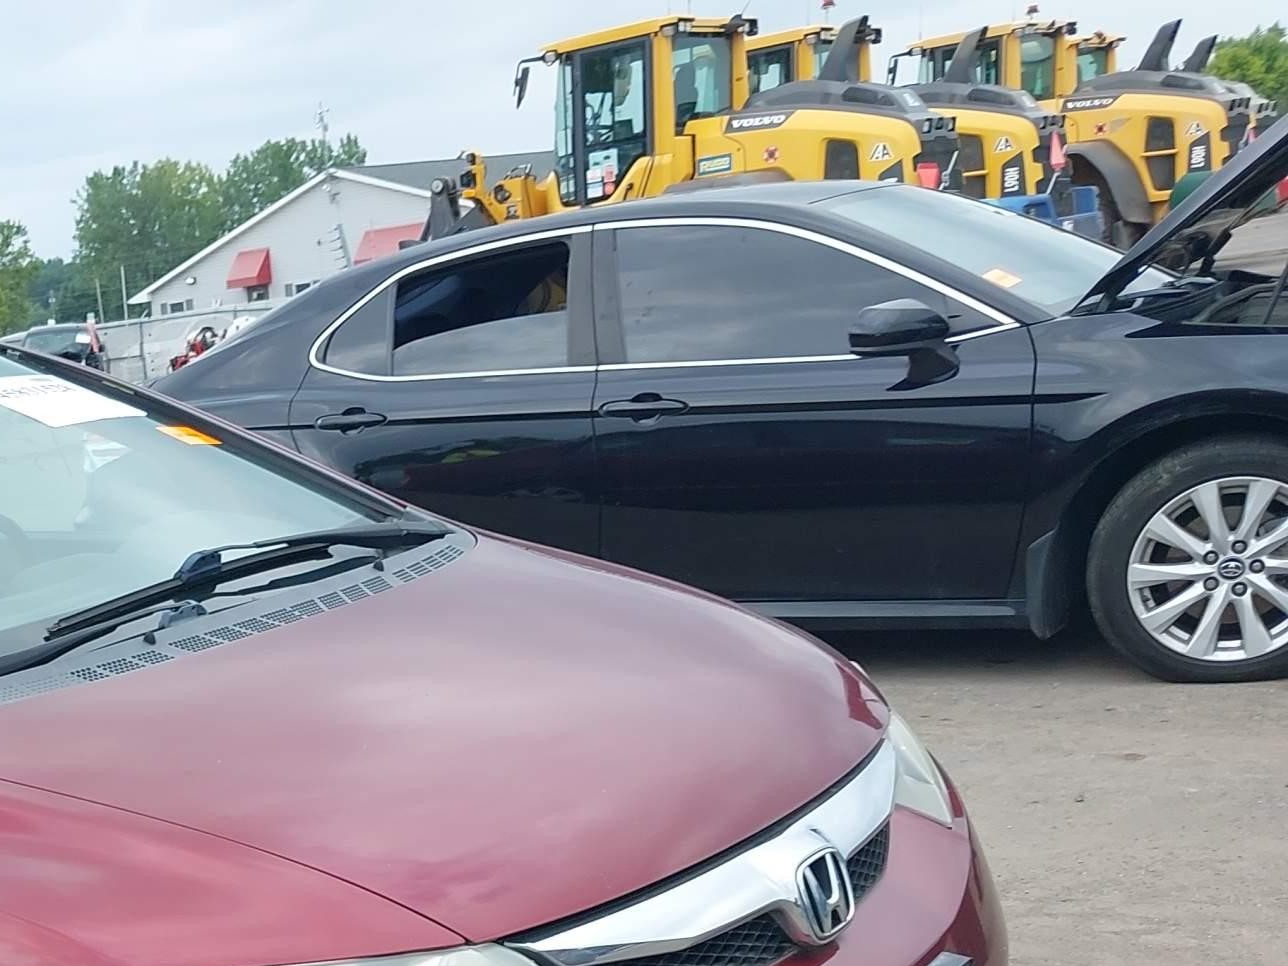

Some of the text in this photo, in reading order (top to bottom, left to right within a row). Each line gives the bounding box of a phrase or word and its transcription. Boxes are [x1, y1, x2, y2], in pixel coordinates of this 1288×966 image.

[1064, 98, 1113, 110] VOLVO
[731, 114, 786, 129] VOLVO
[1003, 166, 1020, 193] L90H
